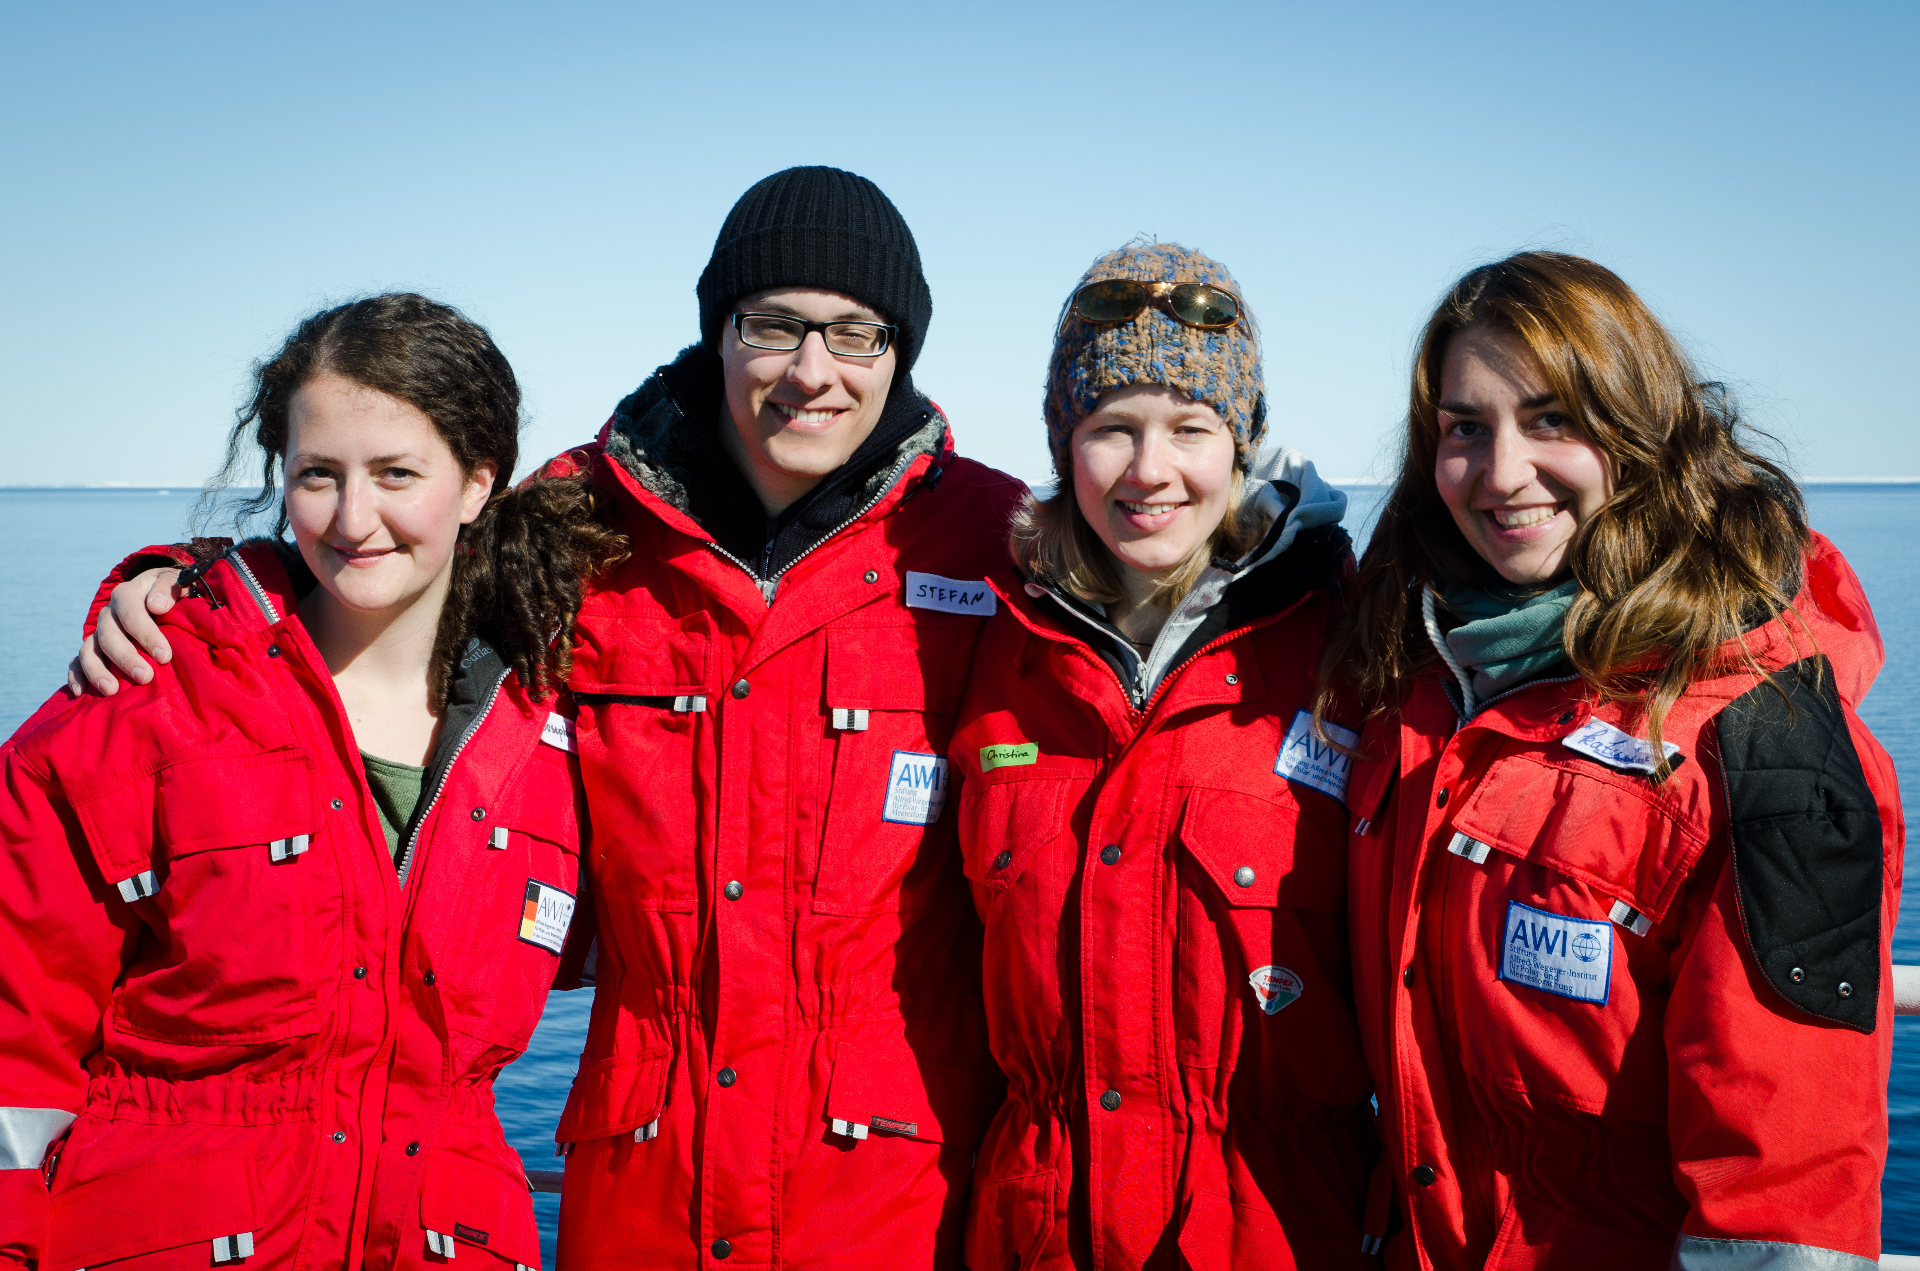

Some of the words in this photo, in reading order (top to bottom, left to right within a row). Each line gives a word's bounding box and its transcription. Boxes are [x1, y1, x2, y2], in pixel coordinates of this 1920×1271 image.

[917, 584, 985, 606] STEFAN
[987, 749, 1030, 761] Christina
[1289, 729, 1350, 774] AWI
[896, 763, 940, 791] AWI
[894, 787, 917, 797] Stiftung
[537, 895, 564, 923] AWI
[1510, 918, 1568, 958] AWI
[1509, 943, 1538, 961] Stiftung
[1263, 974, 1294, 988] TEMPEX
[1510, 968, 1573, 993] Meeresforschung
[1543, 972, 1560, 982] und
[875, 1118, 912, 1132] TEMPEX
[458, 1225, 485, 1240] TEMPEX
